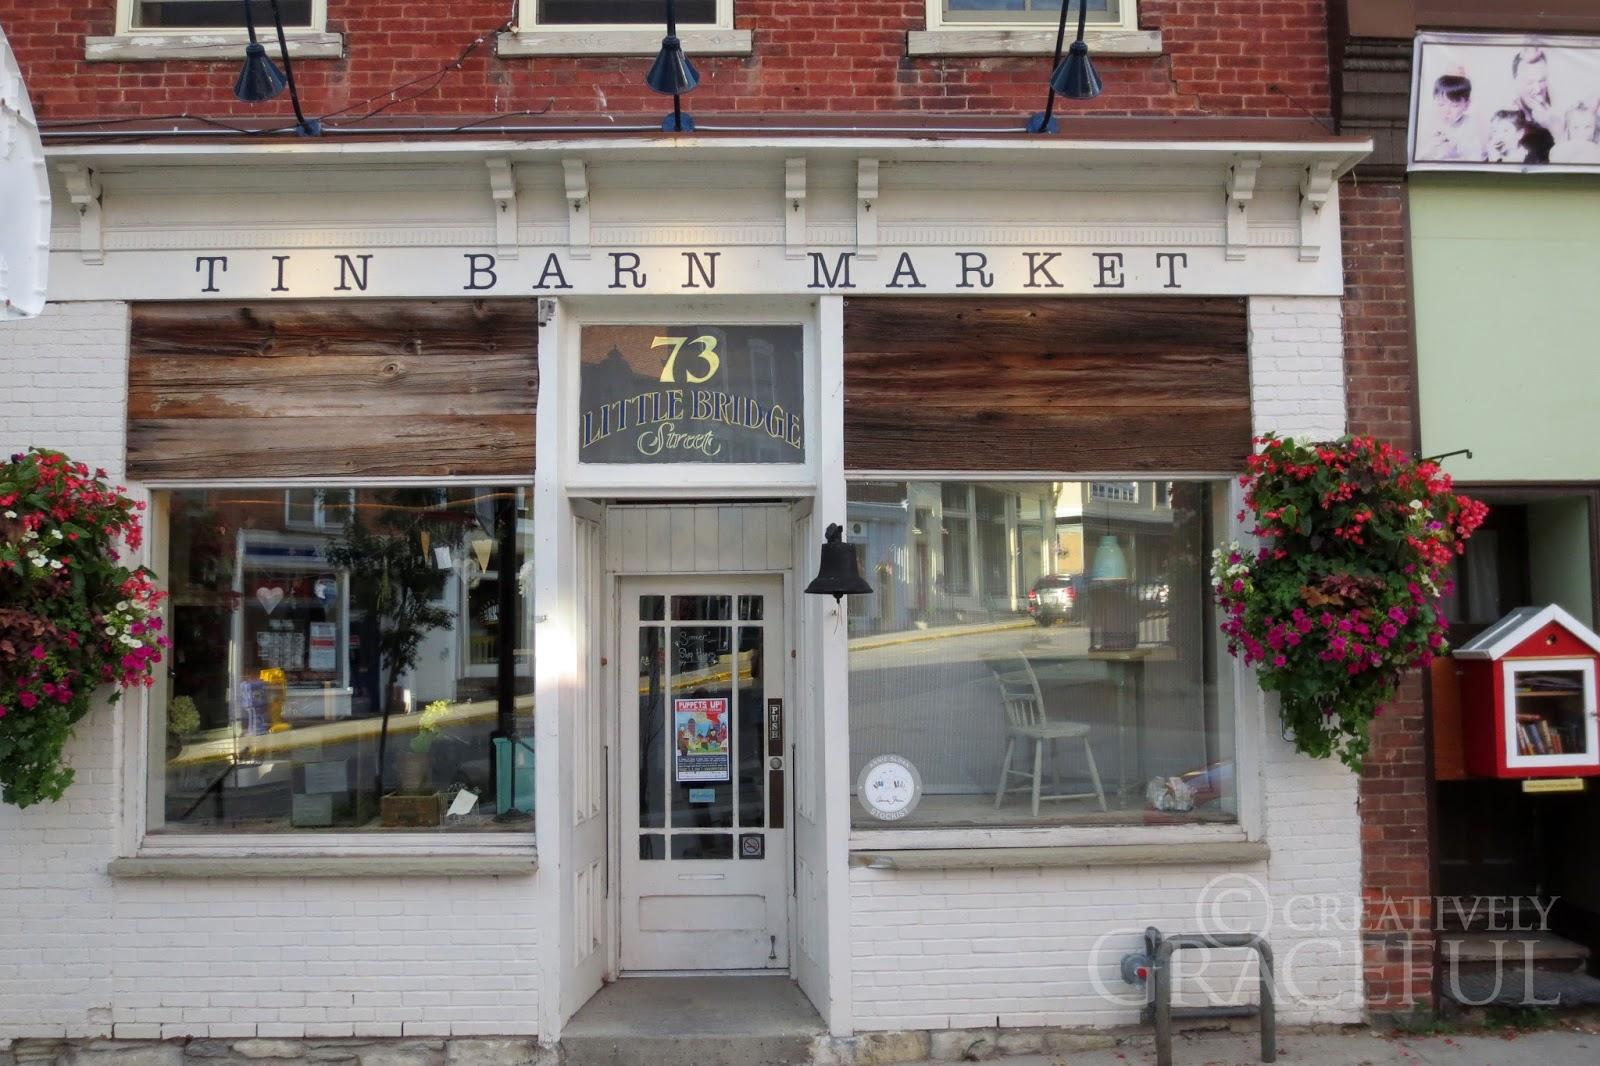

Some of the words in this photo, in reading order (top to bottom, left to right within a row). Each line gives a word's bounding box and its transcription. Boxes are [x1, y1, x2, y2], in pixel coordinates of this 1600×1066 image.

[195, 254, 374, 293] TIN
[463, 251, 722, 291] BARN
[807, 251, 1188, 289] MARKET
[650, 335, 721, 384] 73
[582, 389, 684, 449] LITTLE
[690, 389, 802, 450] BRIDGE
[637, 422, 722, 456] Street
[771, 706, 779, 739] PUSH
